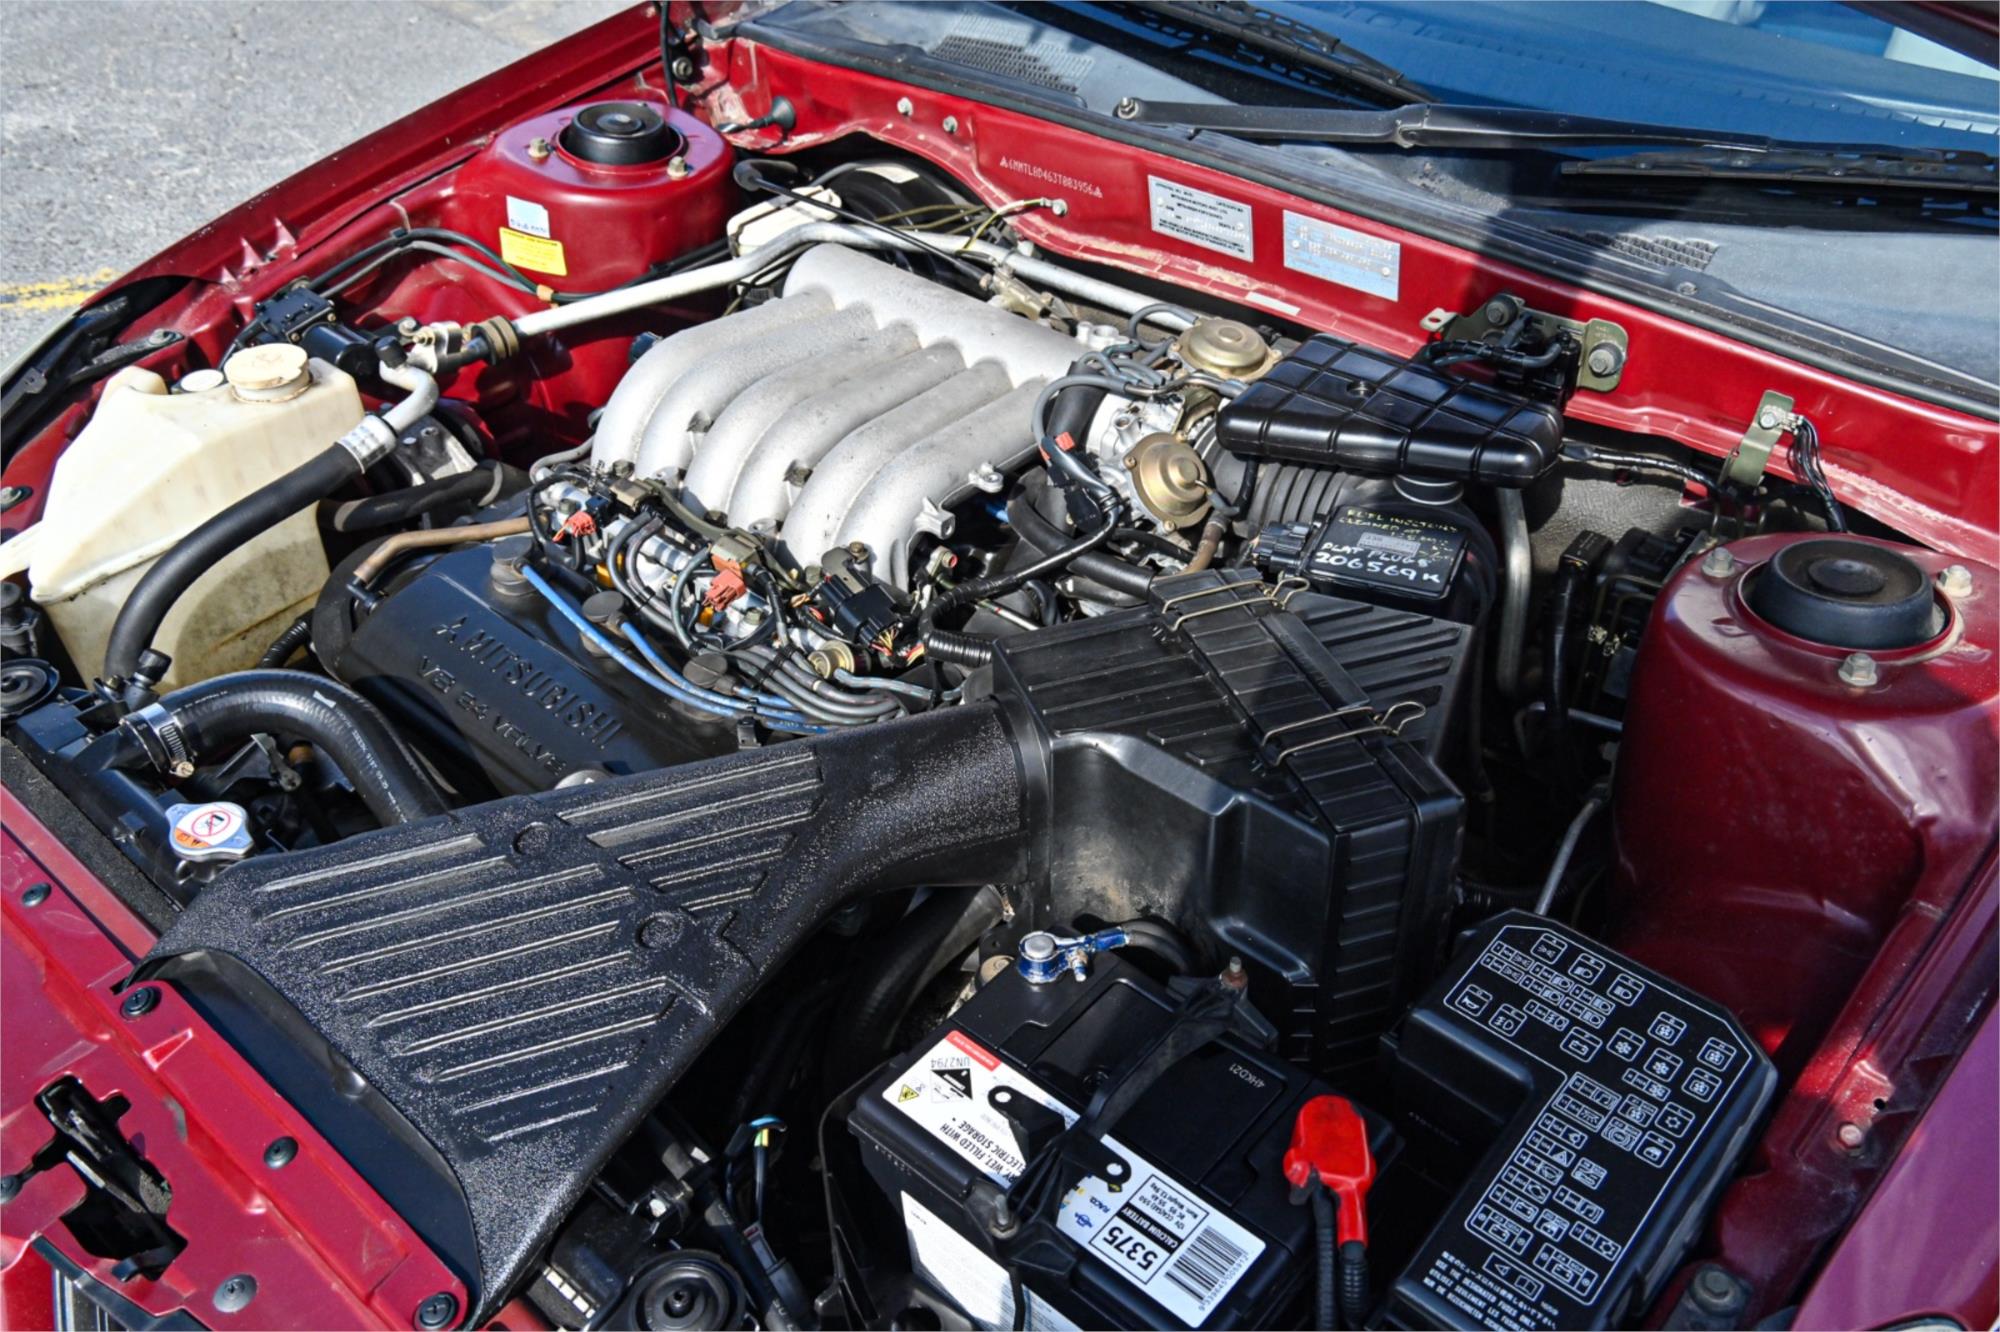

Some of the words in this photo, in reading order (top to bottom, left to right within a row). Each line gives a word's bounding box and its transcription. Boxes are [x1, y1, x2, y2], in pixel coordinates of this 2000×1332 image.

[1321, 542, 1363, 554] PLAT
[460, 628, 624, 750] MITSUBISHI
[931, 1057, 971, 1068] UN2794
[1229, 1063, 1265, 1088] 4HKD21
[940, 1124, 960, 1141] WITH
[959, 1121, 993, 1148] STORAGE
[960, 1138, 985, 1160] FILLED
[1122, 1207, 1150, 1229] BATTERY
[1149, 1225, 1177, 1247] CALCIUM
[1103, 1226, 1157, 1269] 5375
